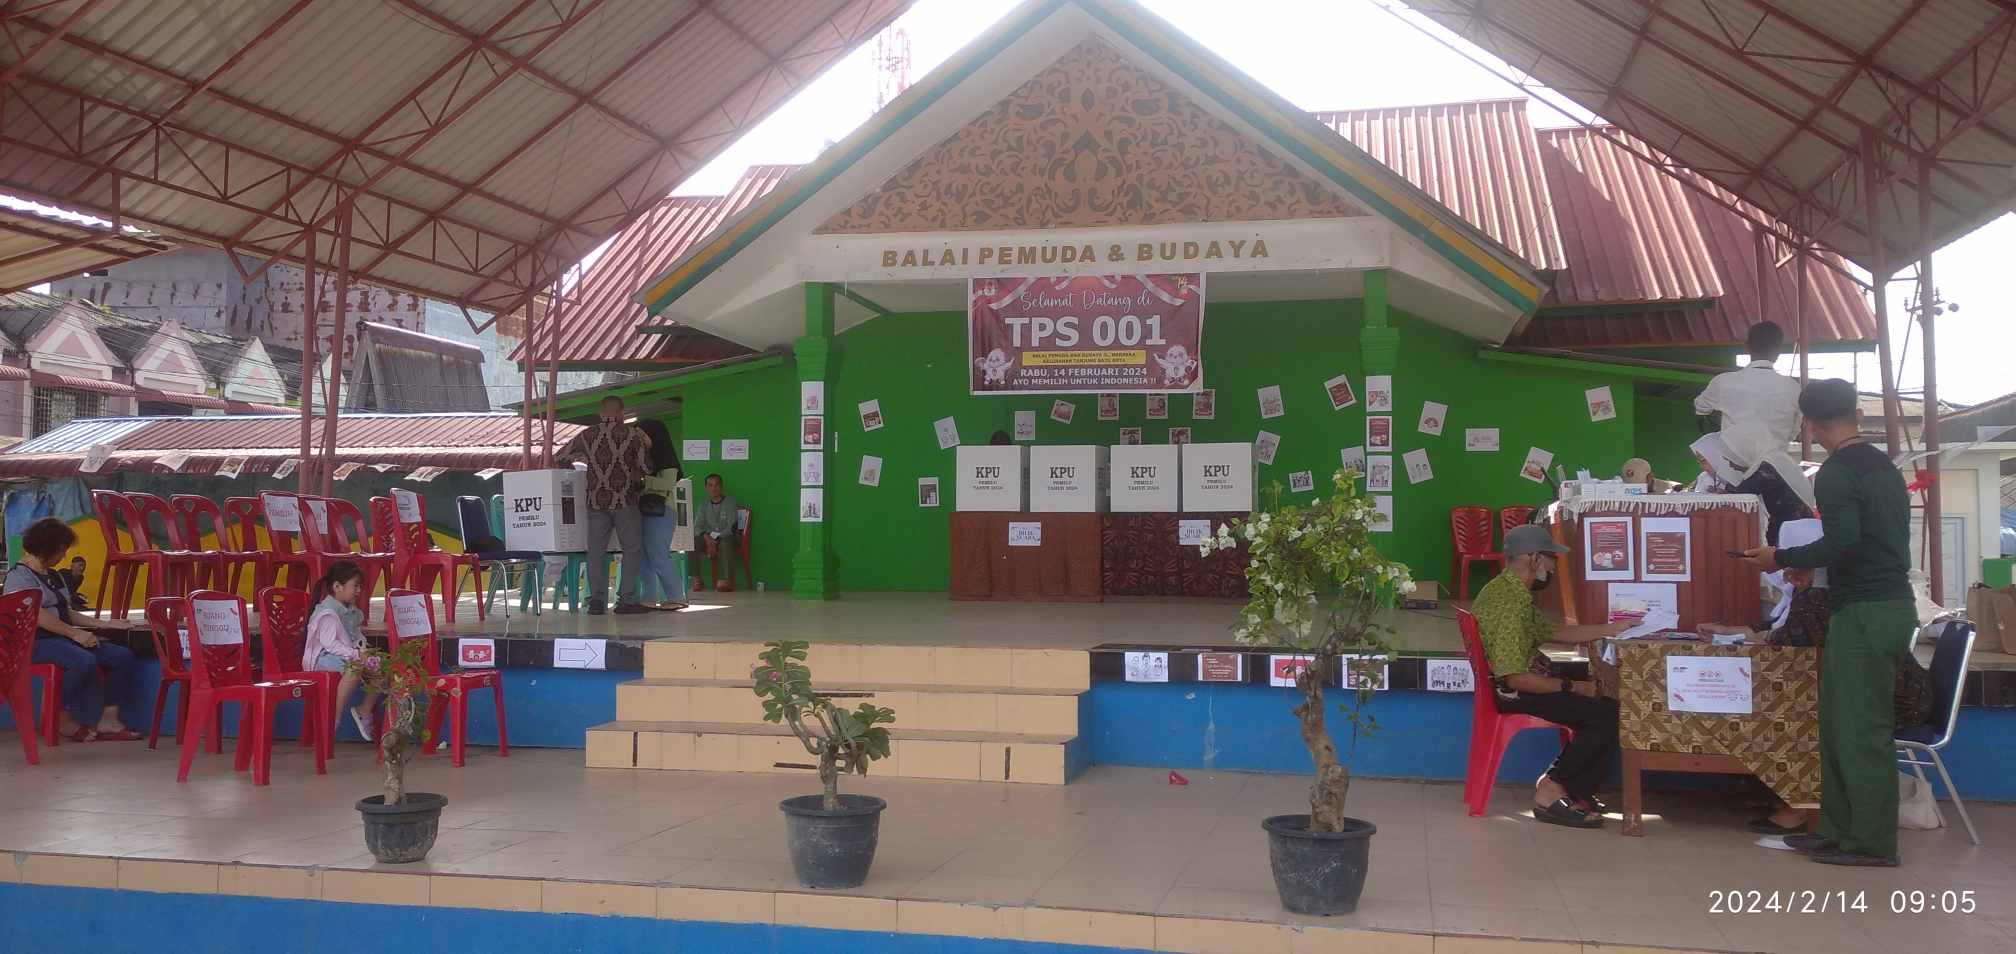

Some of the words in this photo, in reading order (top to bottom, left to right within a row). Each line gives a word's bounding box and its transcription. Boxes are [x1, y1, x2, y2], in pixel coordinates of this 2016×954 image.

[881, 248, 969, 267] BALAI
[978, 244, 1096, 265] PEMUDA
[1107, 244, 1126, 262] &
[1136, 239, 1270, 261] BUDAYA
[1020, 288, 1075, 311] Selamat
[1082, 289, 1132, 313] Datang
[1137, 289, 1153, 306] di
[1004, 315, 1080, 347] TPS
[1092, 314, 1167, 346] 001
[1020, 368, 1051, 377] RABU,
[1054, 368, 1066, 376] 14
[1068, 368, 1119, 376] FEBRUARI
[1122, 367, 1147, 376] 2024
[1031, 377, 1068, 385] MEMILIH
[1070, 377, 1099, 385] UNTUK
[1100, 376, 1148, 384] INDONESIA
[975, 466, 1001, 478] KPU
[1050, 466, 1075, 478] KPU
[1130, 466, 1157, 478] KPU
[1203, 465, 1231, 477] KPU
[514, 496, 543, 513] KPU
